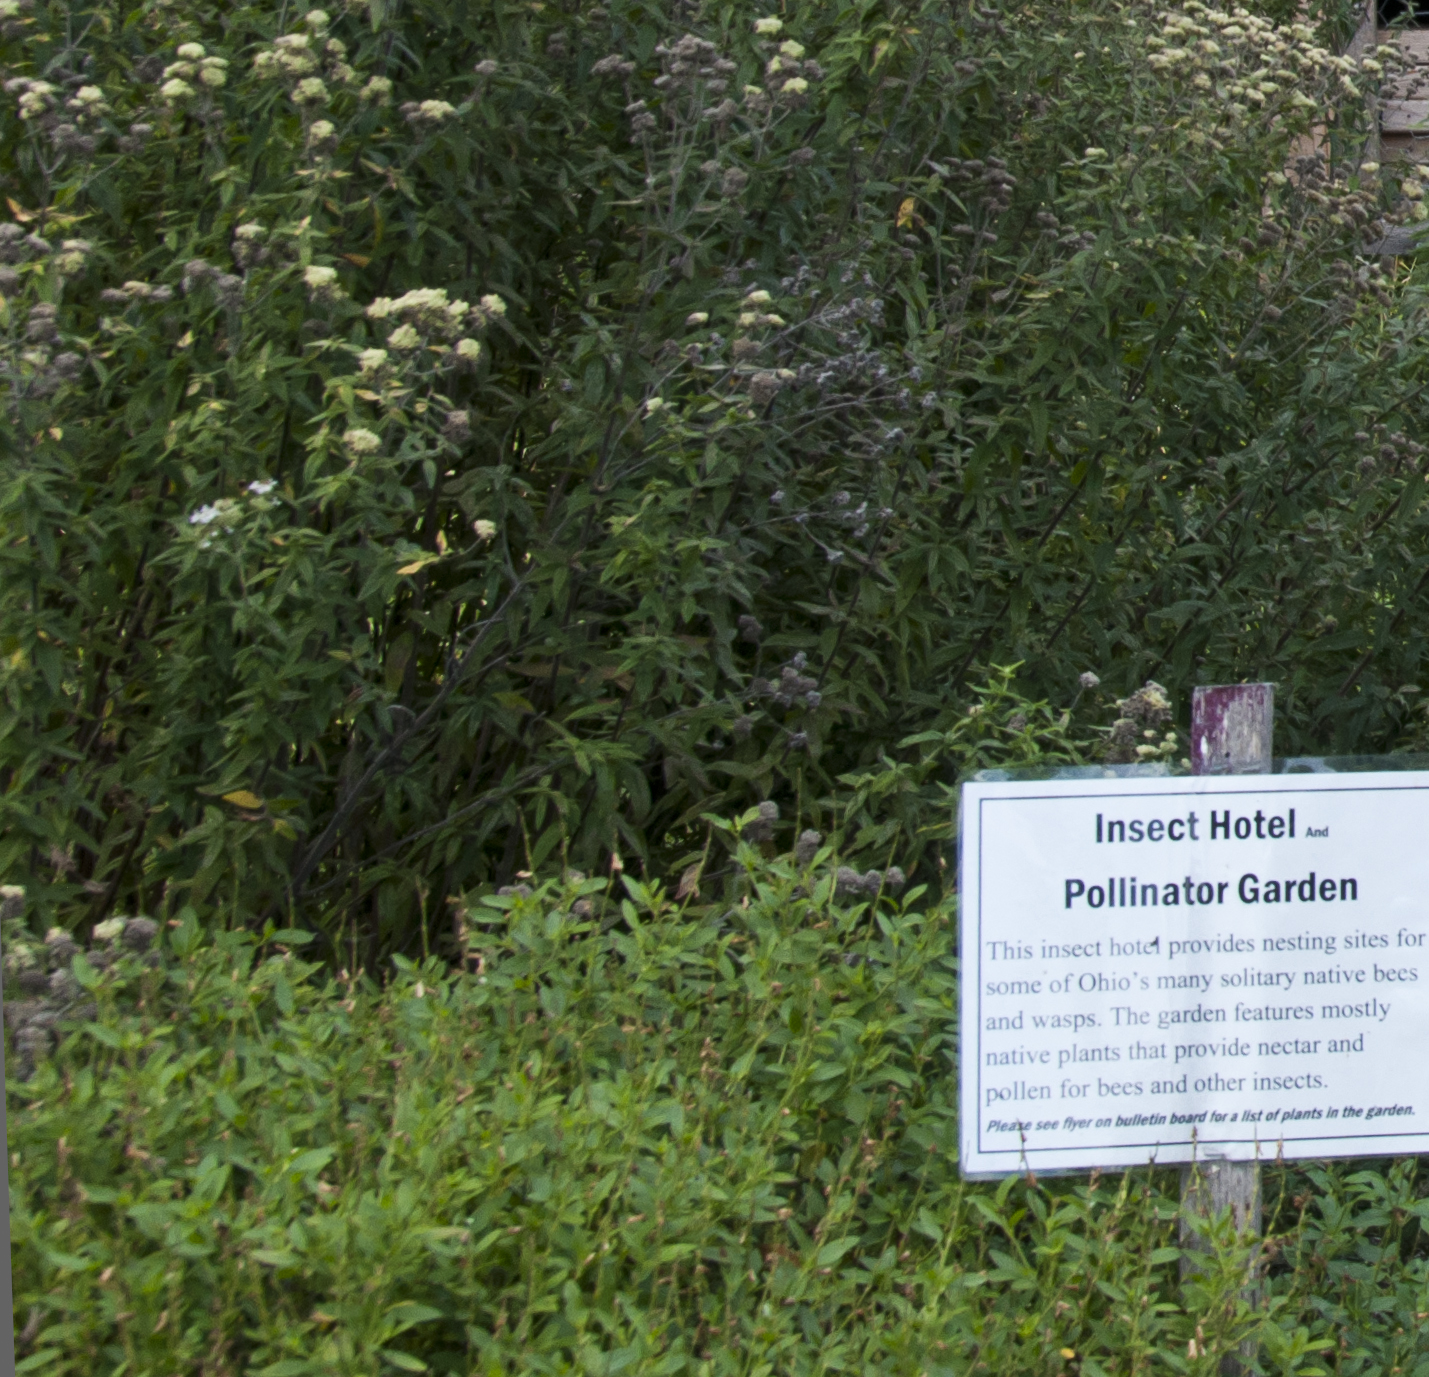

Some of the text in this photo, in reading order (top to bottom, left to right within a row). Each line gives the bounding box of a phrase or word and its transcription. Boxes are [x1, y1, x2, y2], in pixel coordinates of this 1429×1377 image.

[1096, 808, 1329, 843] Insect Hotel And
[1065, 872, 1358, 909] Pollinator Garden
[987, 928, 1426, 960] This insect hotel provides nesting sites for
[987, 964, 1418, 995] some of Ohio's many solitary native bees
[986, 999, 1390, 1032] and wasps. The garden features mostly
[987, 1033, 1363, 1068] native plants that provide nectar and
[987, 1072, 1327, 1106] pollen for bees and other insects.
[987, 1104, 1415, 1132] Please see flyer on bulletin board for a list of plants in the garden.
